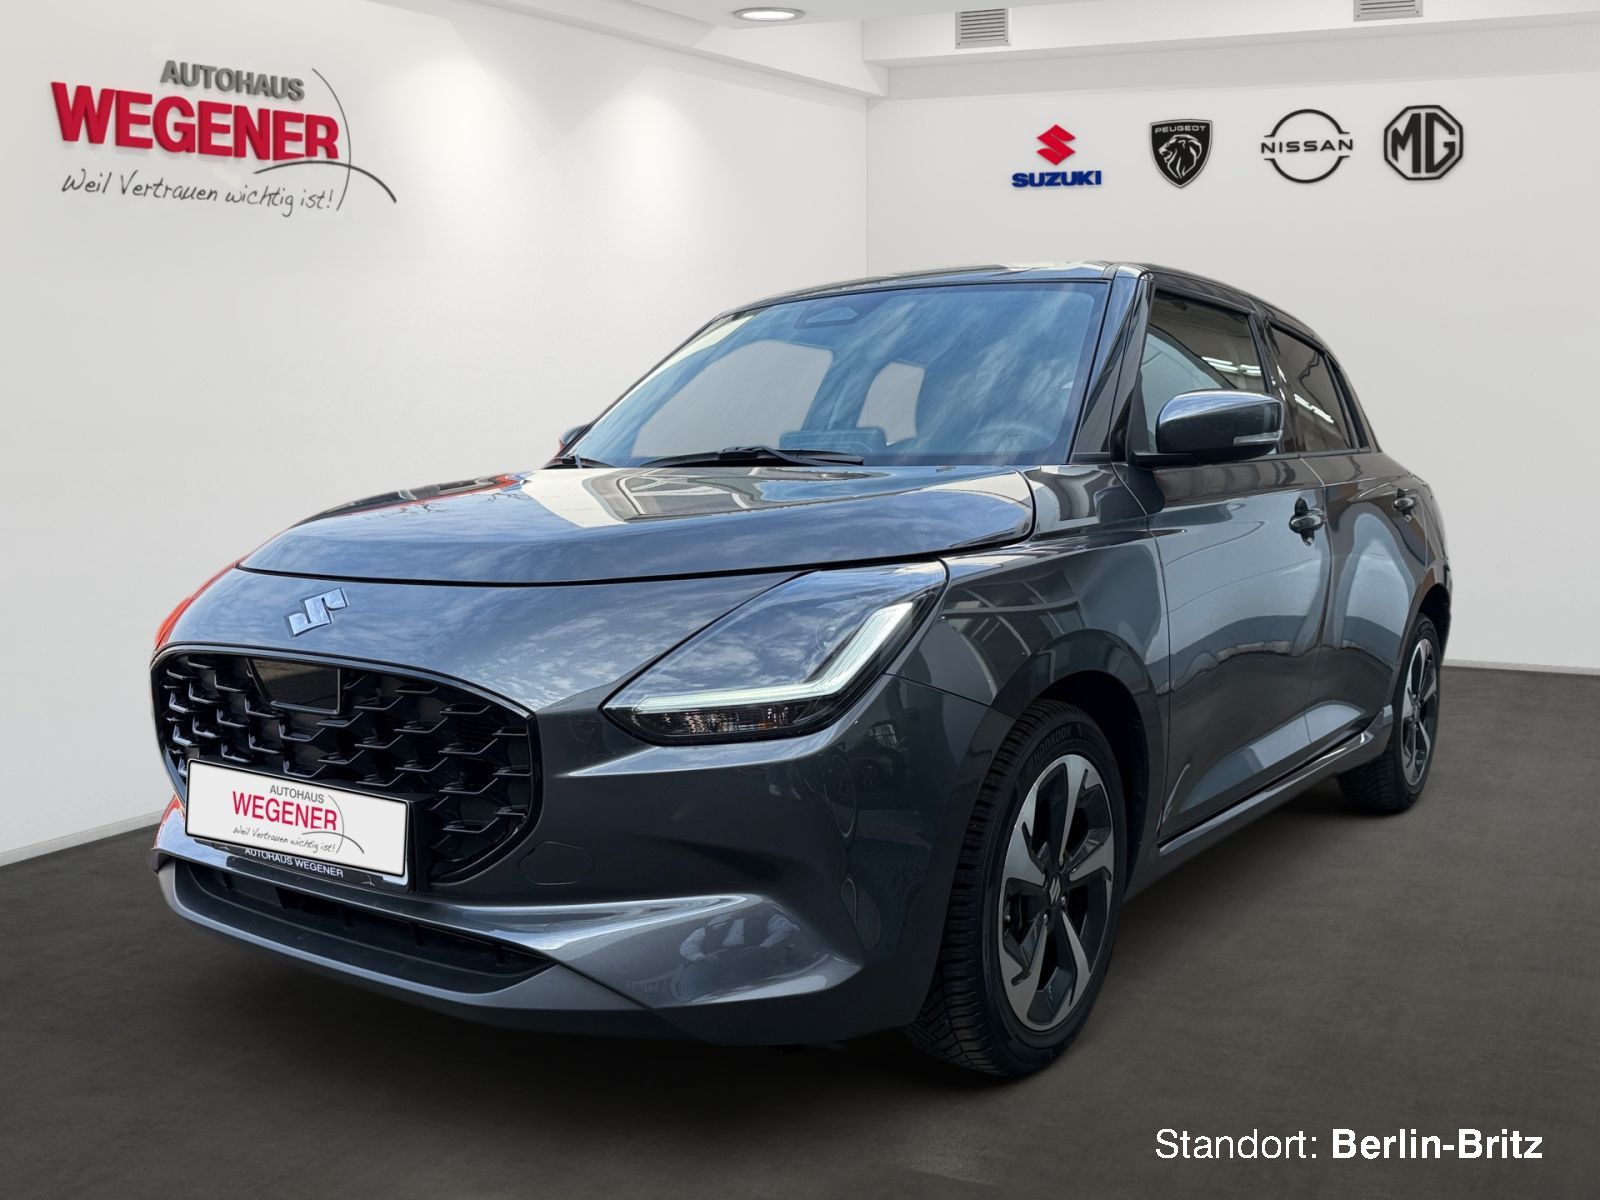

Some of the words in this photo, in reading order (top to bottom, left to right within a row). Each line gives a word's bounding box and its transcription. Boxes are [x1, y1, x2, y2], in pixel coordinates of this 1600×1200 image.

[159, 60, 305, 101] AUTOHAUS
[51, 81, 339, 161] WEGENER
[1154, 124, 1207, 134] PEUGEOT
[1261, 138, 1354, 154] NISSAN
[1391, 111, 1457, 174] MG
[62, 168, 112, 194] Weil
[120, 169, 218, 202] Vertrauen
[225, 184, 295, 218] wichtig
[300, 189, 334, 210] ist!
[1011, 169, 1102, 188] SUZUKI
[269, 784, 325, 804] AUTOHAUS
[232, 791, 338, 831] WEGENER
[233, 825, 250, 837] Weil
[252, 827, 289, 844] Vertrauen
[290, 836, 319, 854] wichtig
[320, 842, 336, 853] ist!
[244, 848, 293, 866] AUTOHAUS
[295, 858, 344, 878] WEGENER
